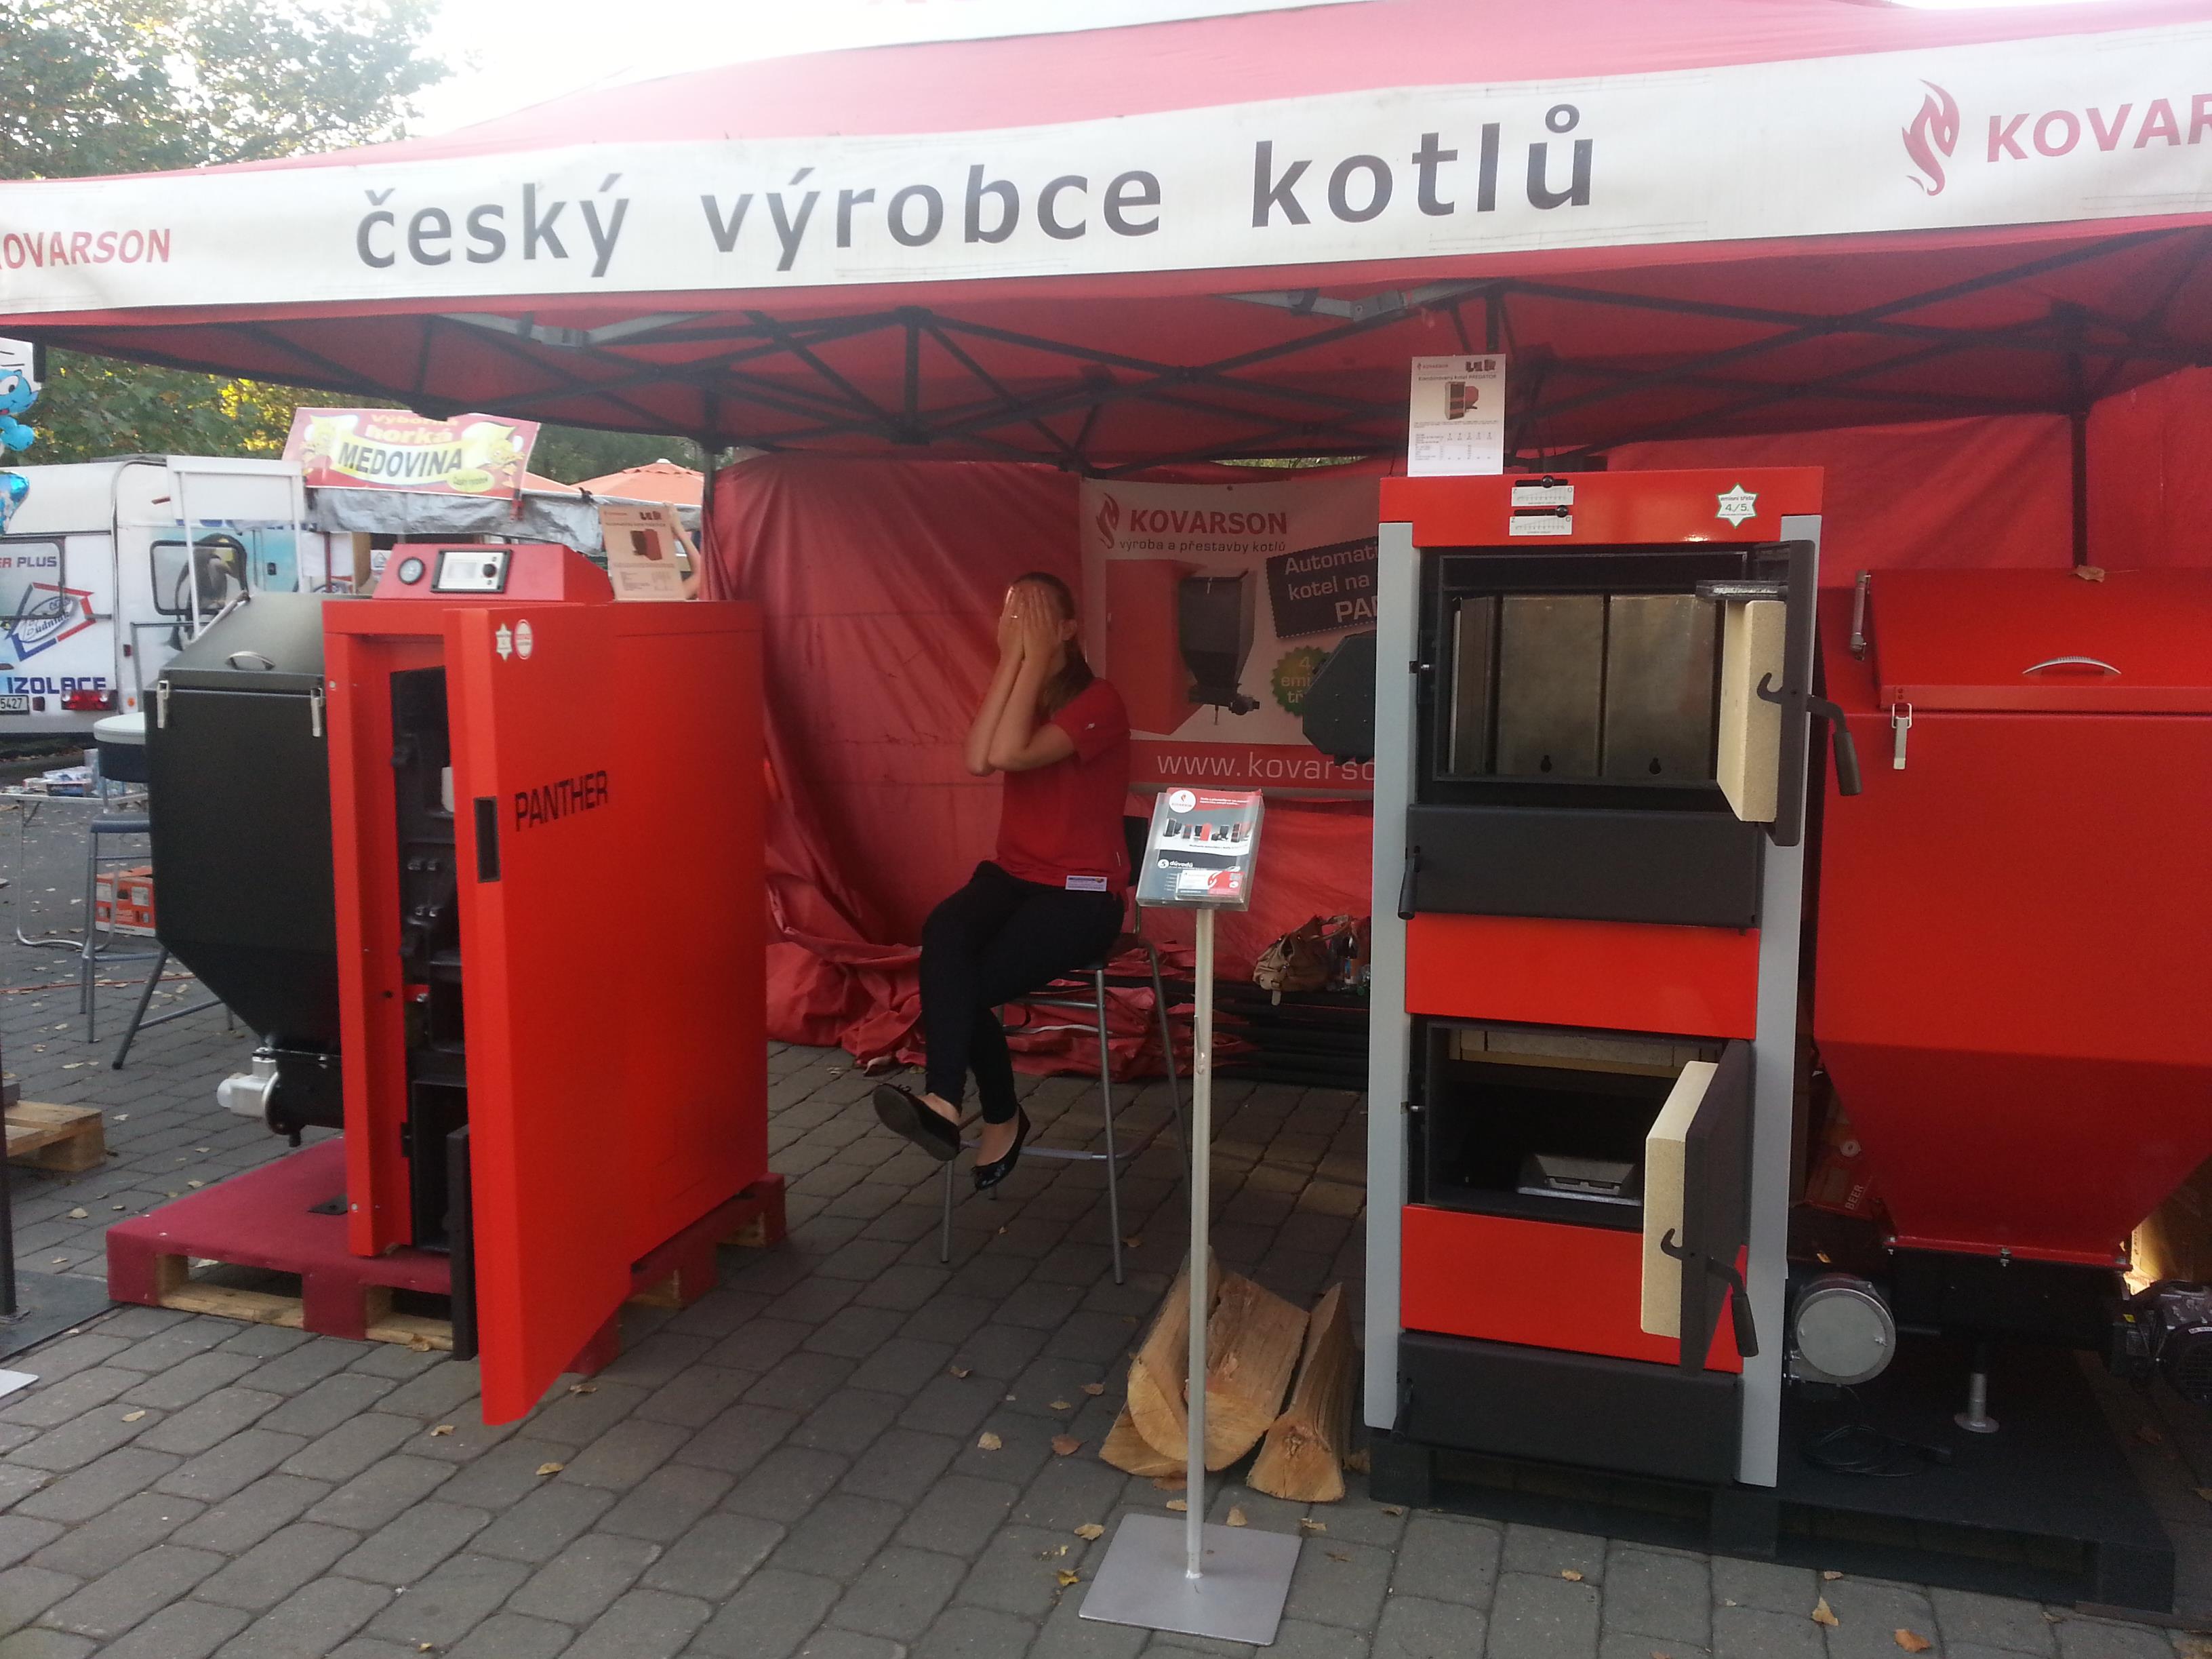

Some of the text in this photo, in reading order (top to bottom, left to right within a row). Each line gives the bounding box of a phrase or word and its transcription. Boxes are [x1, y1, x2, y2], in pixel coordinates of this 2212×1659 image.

[357, 103, 1593, 278] český výrobce kotlů
[0, 228, 170, 270] OVARSON
[365, 424, 454, 444] horká
[338, 442, 462, 477] MEDOVINA
[1130, 509, 1287, 535] KOVARSON
[1119, 539, 1164, 551] výroba
[1180, 541, 1248, 554] přestavby
[1253, 540, 1286, 553] kotlů
[17, 556, 57, 567] PLUS
[1288, 574, 1370, 601] kotel na
[515, 770, 608, 832] PANTHER
[1845, 1184, 1864, 1210] BEER
